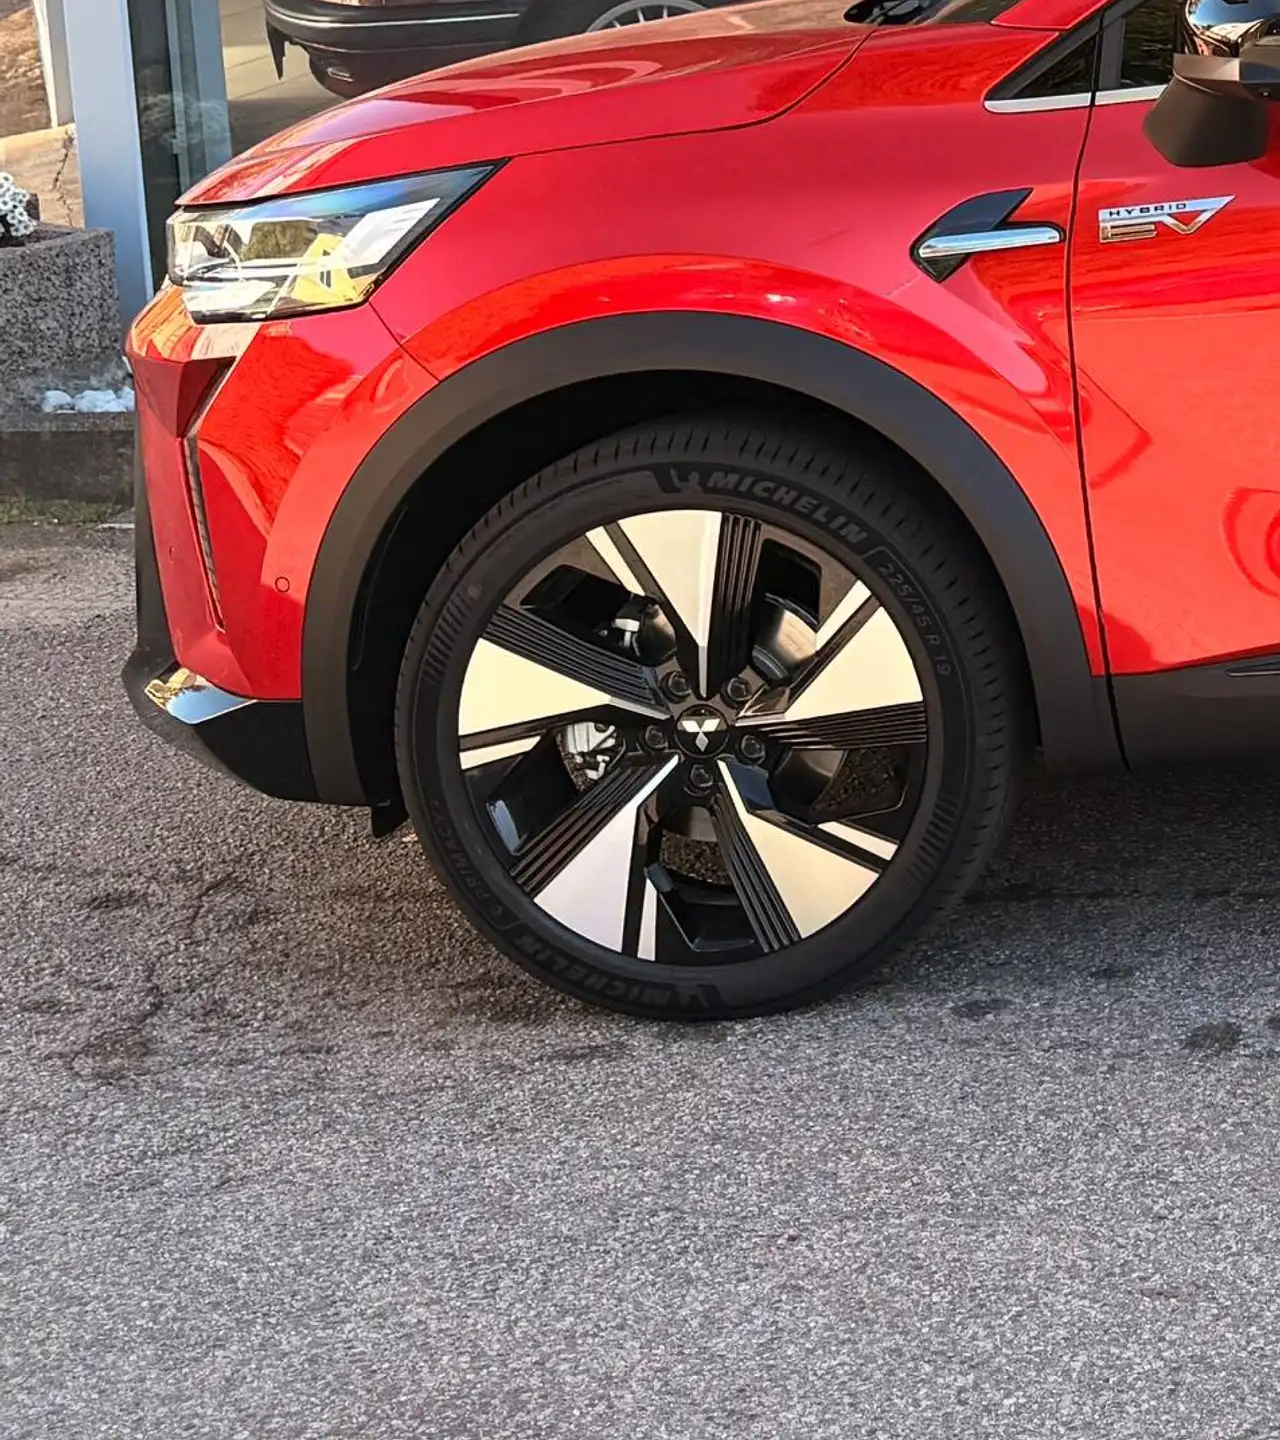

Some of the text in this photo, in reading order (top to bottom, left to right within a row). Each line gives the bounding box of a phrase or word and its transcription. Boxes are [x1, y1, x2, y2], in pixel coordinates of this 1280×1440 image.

[1108, 203, 1187, 217] HYBRID
[707, 470, 869, 545] MICHELIN
[877, 562, 952, 676] 225/45 R 19
